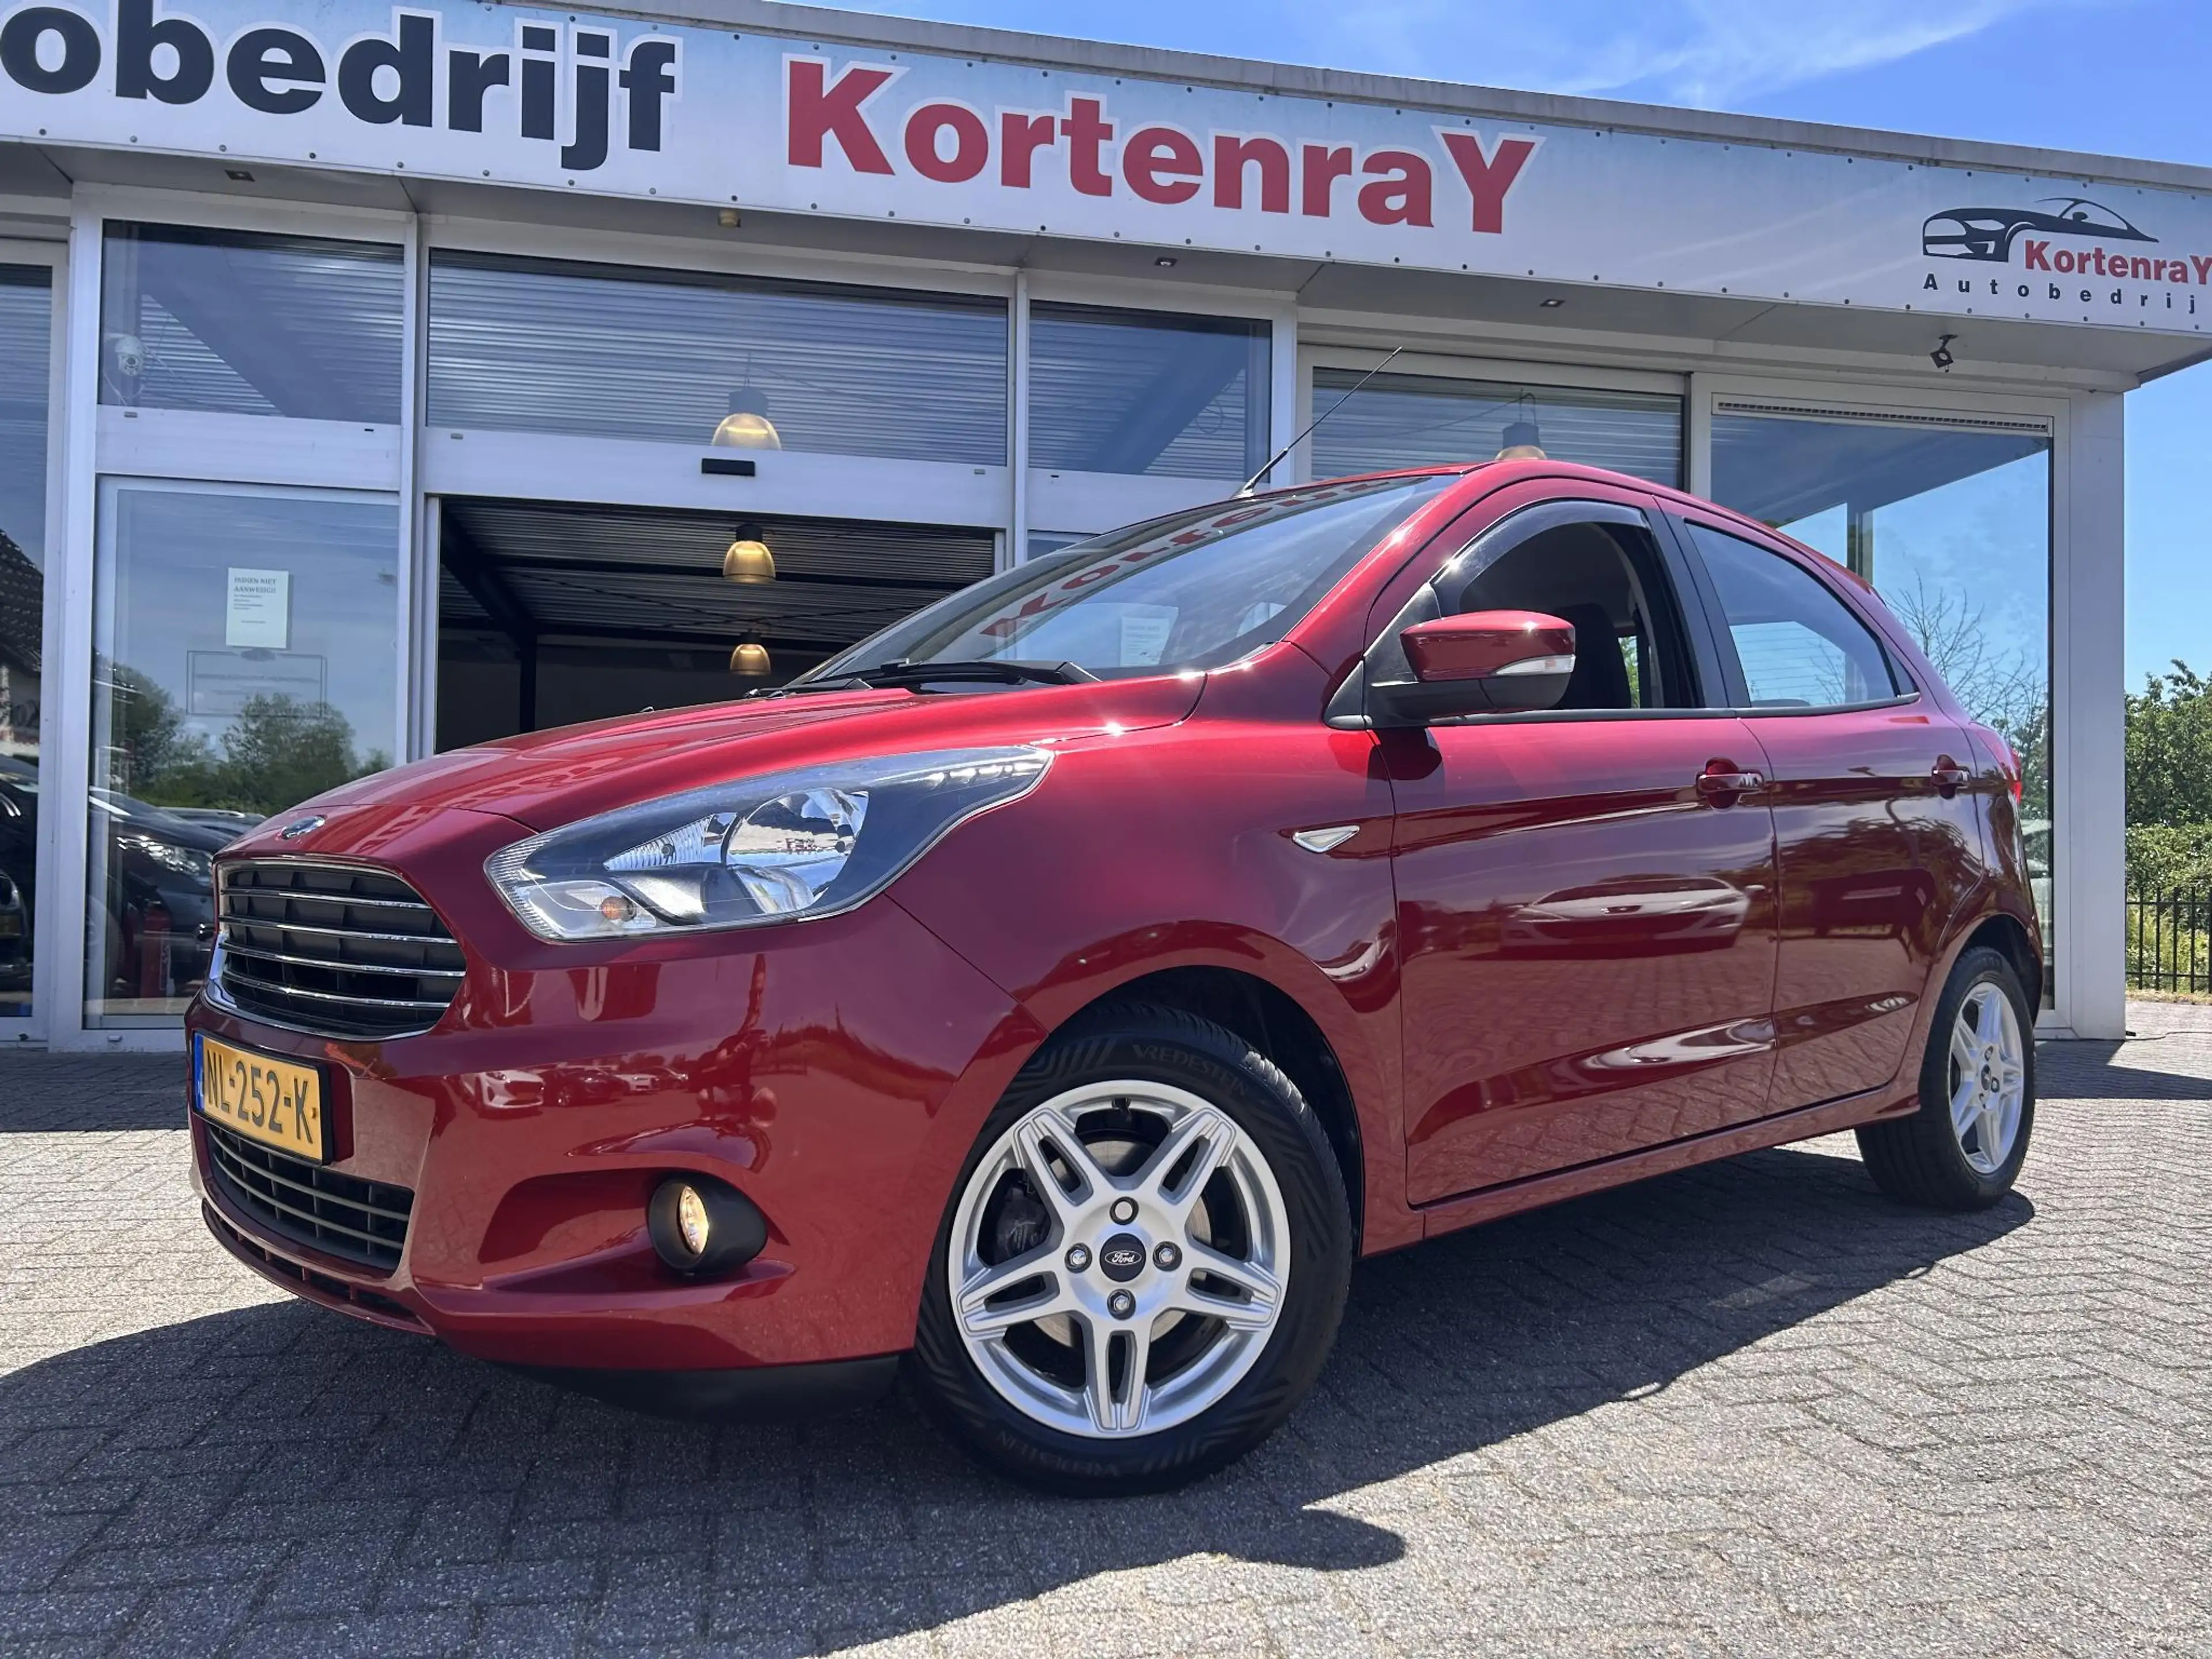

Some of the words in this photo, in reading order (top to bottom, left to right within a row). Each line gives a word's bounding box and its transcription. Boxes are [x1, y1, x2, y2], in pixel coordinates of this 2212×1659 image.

[1, 0, 676, 172] obedrijf
[787, 60, 1537, 234] KortenraY
[2024, 240, 2212, 285] KortenraY
[207, 1049, 313, 1145] NL-252-K
[1112, 1253, 1135, 1263] Ford
